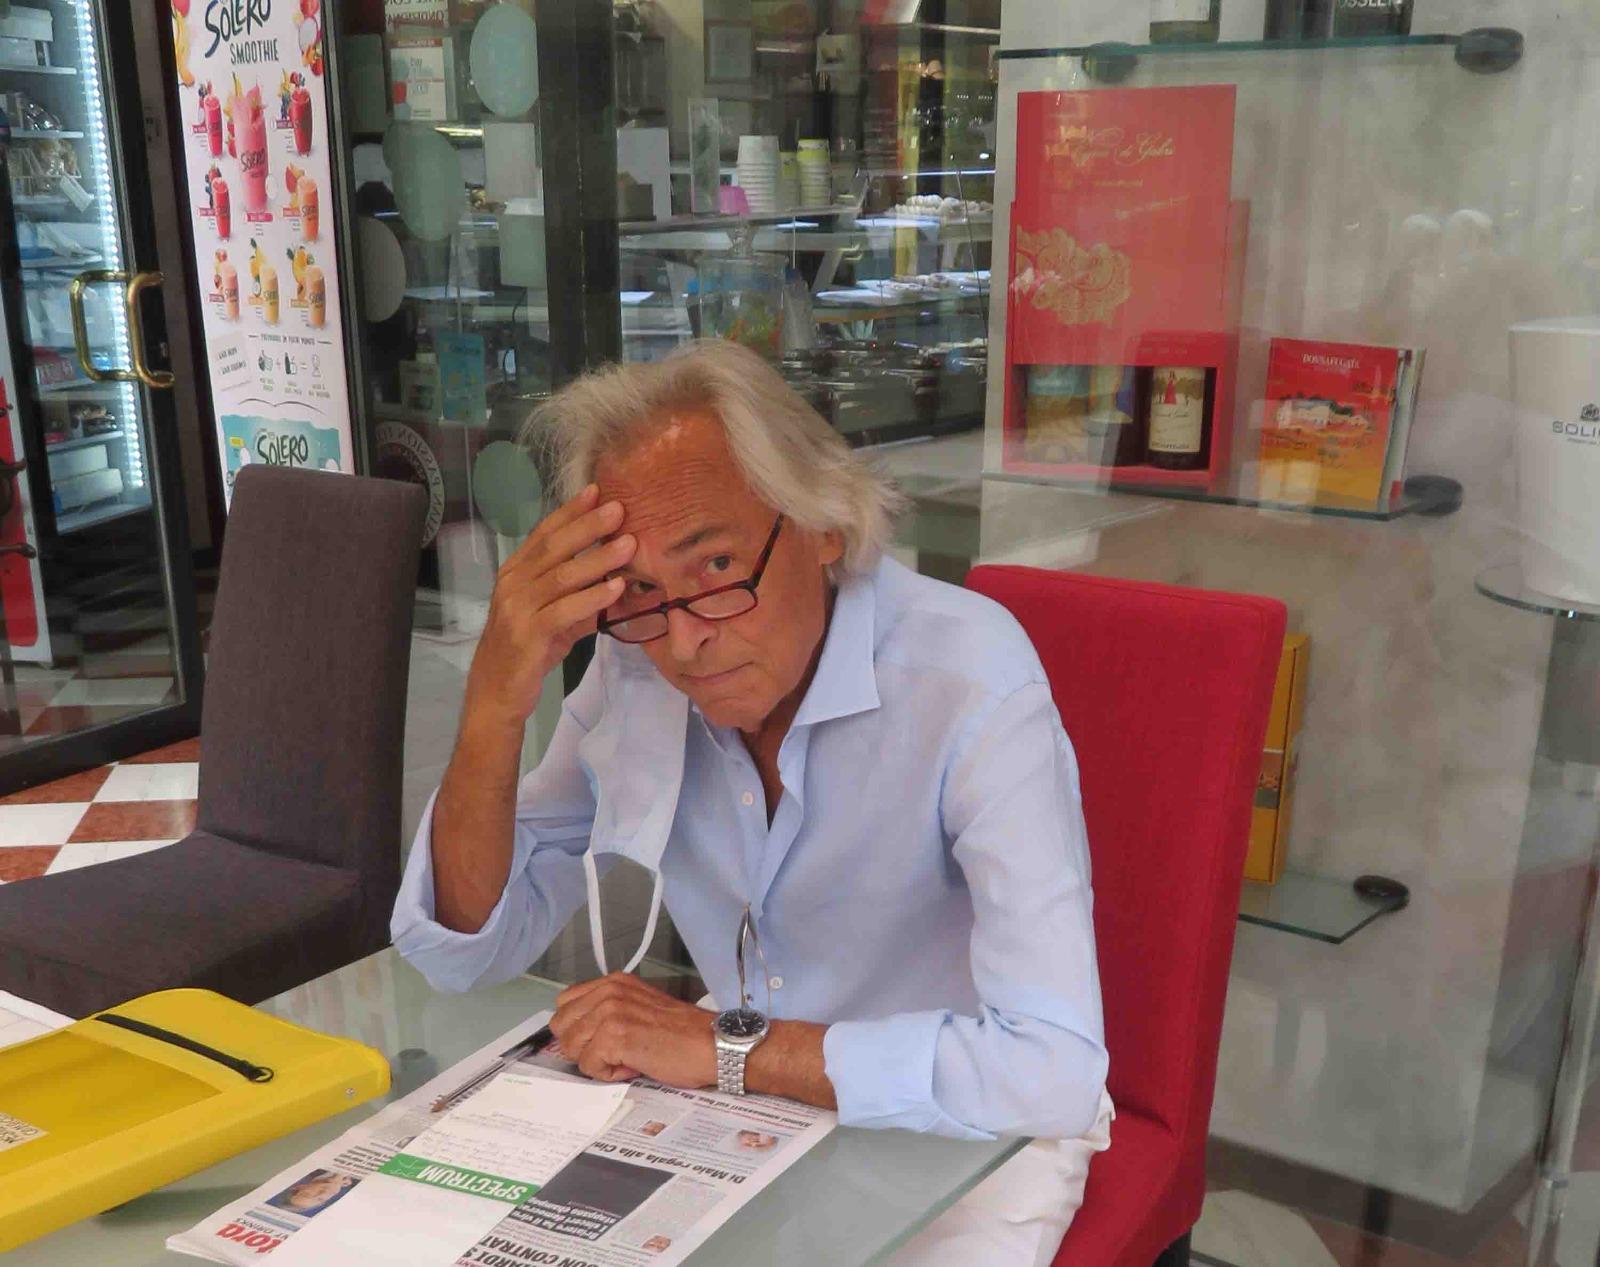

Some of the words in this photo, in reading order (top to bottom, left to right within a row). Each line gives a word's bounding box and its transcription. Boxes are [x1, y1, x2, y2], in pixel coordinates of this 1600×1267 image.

[205, 0, 271, 58] SOLERO
[230, 38, 279, 65] SMOOTHIE
[1552, 420, 1600, 438] SOLI
[257, 434, 308, 467] SOLERO
[616, 1147, 645, 1159] alla
[643, 1153, 691, 1168] regala
[417, 1163, 529, 1201] SPECTRUM
[690, 1164, 729, 1179] Maio
[727, 1174, 747, 1184] Di
[476, 1234, 560, 1265] CONTRAT
